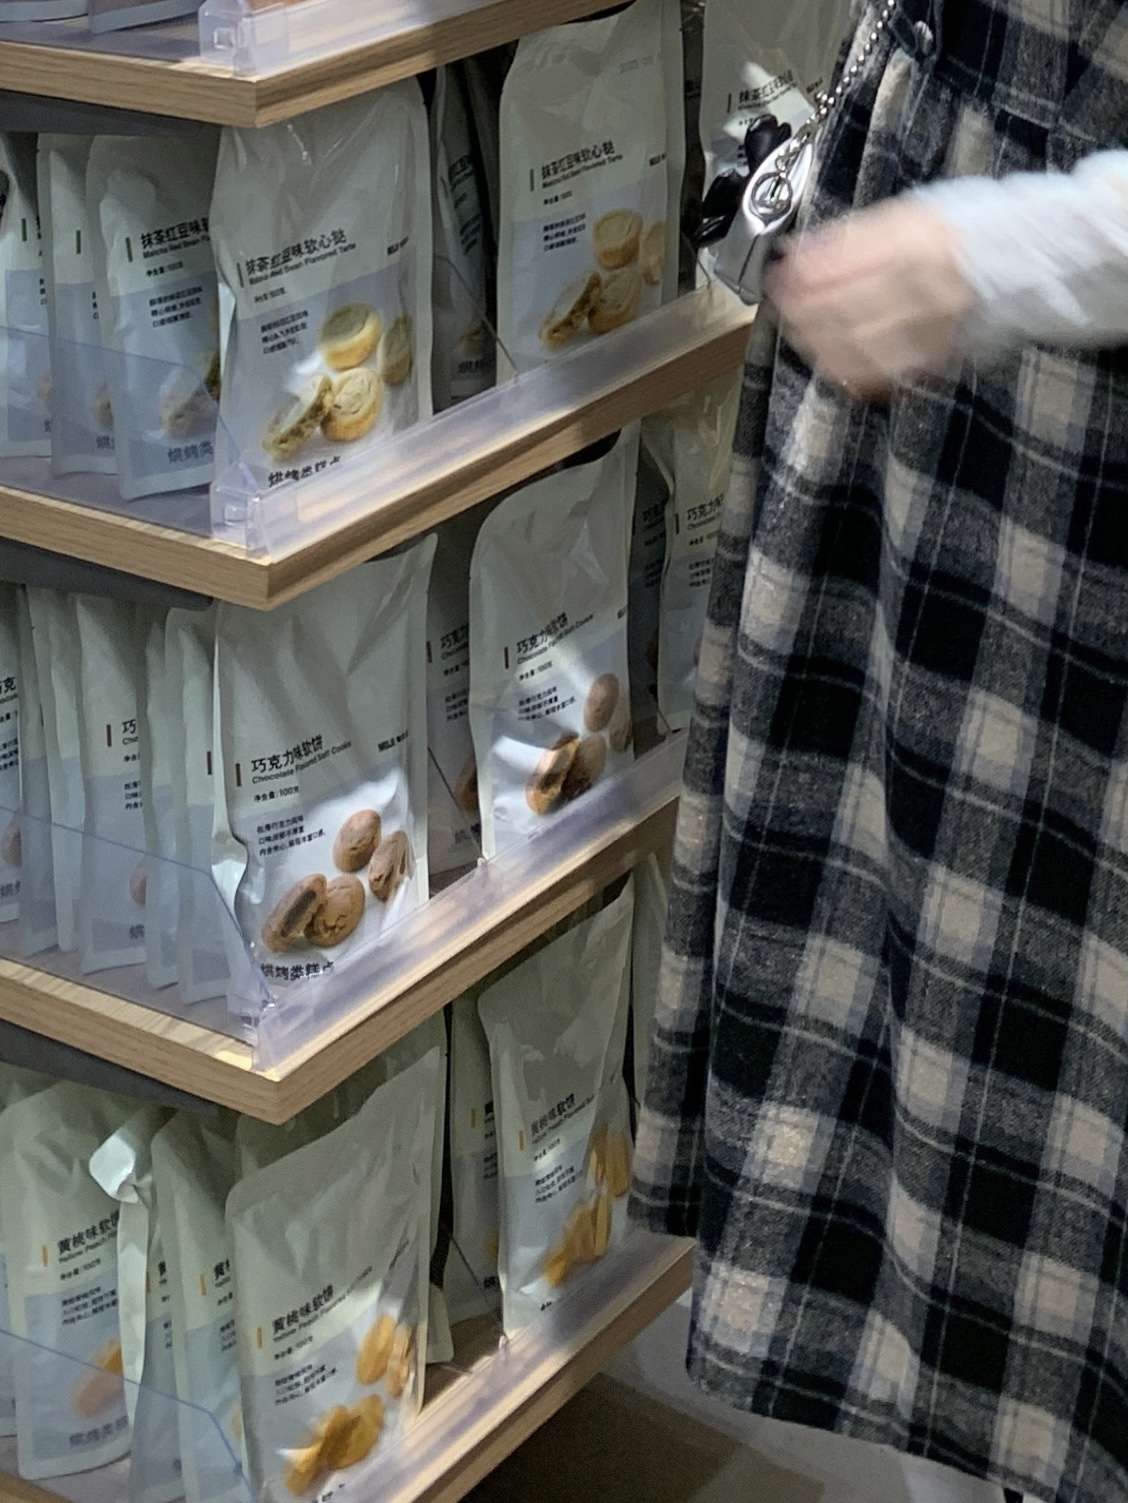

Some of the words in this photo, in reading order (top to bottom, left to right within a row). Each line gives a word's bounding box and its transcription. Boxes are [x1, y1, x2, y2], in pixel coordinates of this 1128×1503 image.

[245, 228, 347, 275] 抹茶红豆味软心挞
[251, 734, 323, 773] 巧克力味软饼
[252, 768, 294, 784] Chocolate
[273, 1285, 333, 1336] 黄桃味软饼
